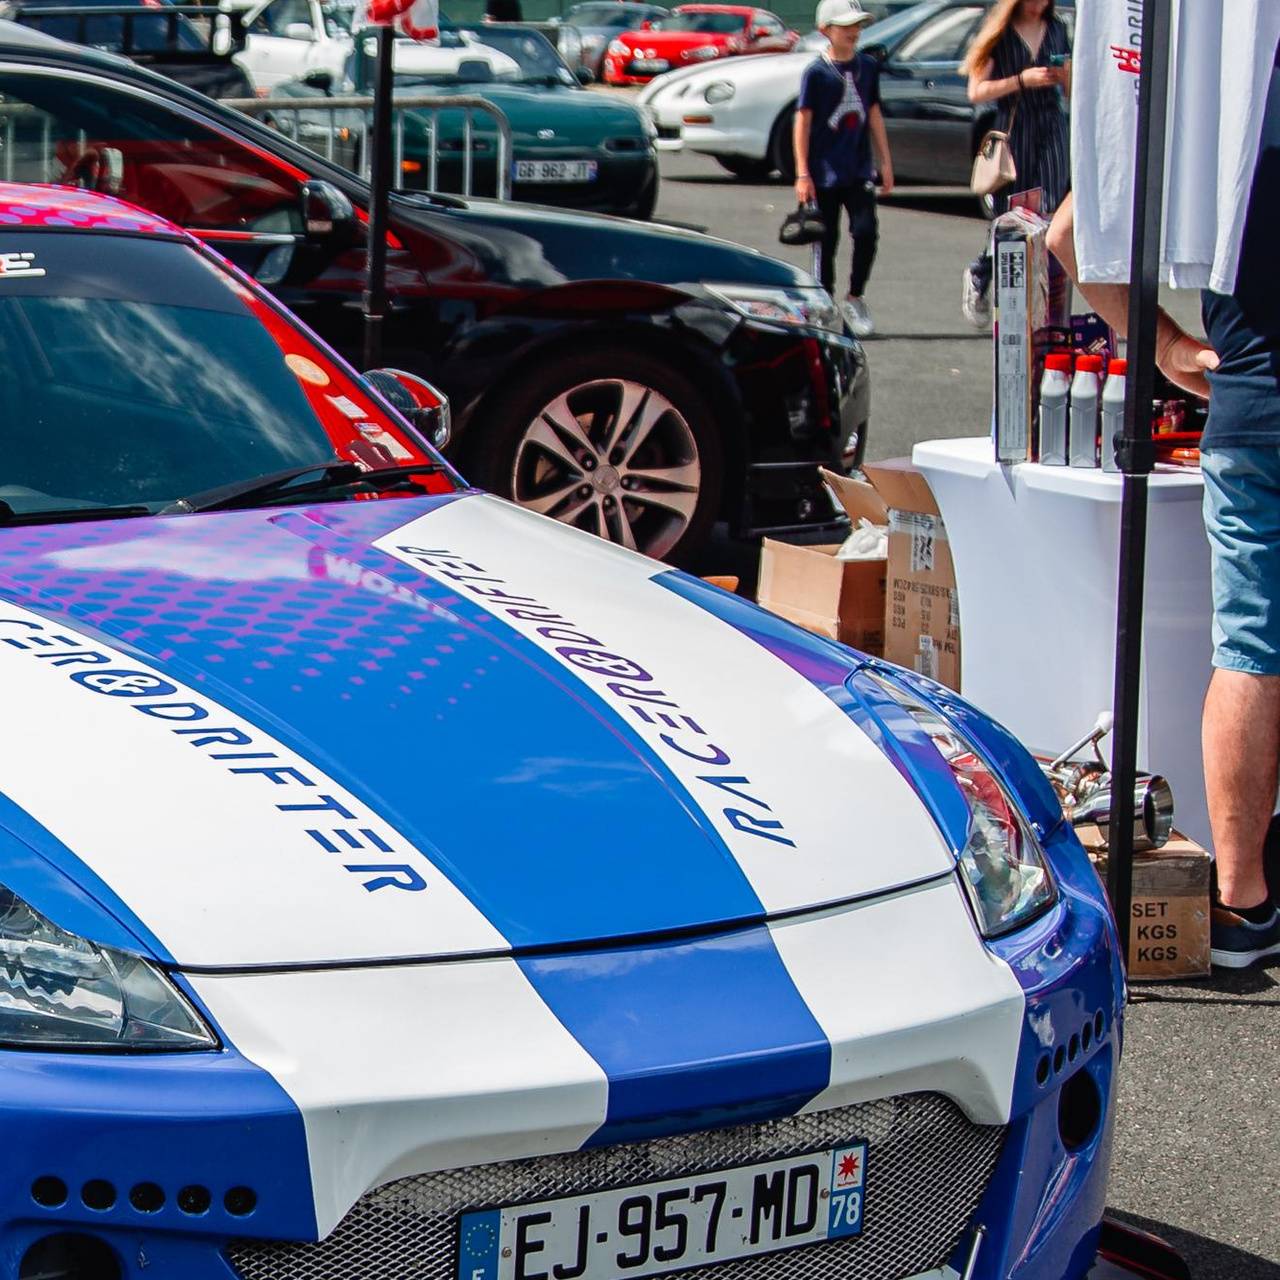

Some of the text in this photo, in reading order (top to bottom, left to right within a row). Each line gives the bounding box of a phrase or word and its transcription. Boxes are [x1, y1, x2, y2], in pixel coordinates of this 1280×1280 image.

[1011, 252, 1024, 288] HKS
[1132, 902, 1168, 918] SET
[1137, 924, 1177, 941] KGS
[1138, 946, 1178, 963] KGS
[832, 1191, 861, 1228] 78
